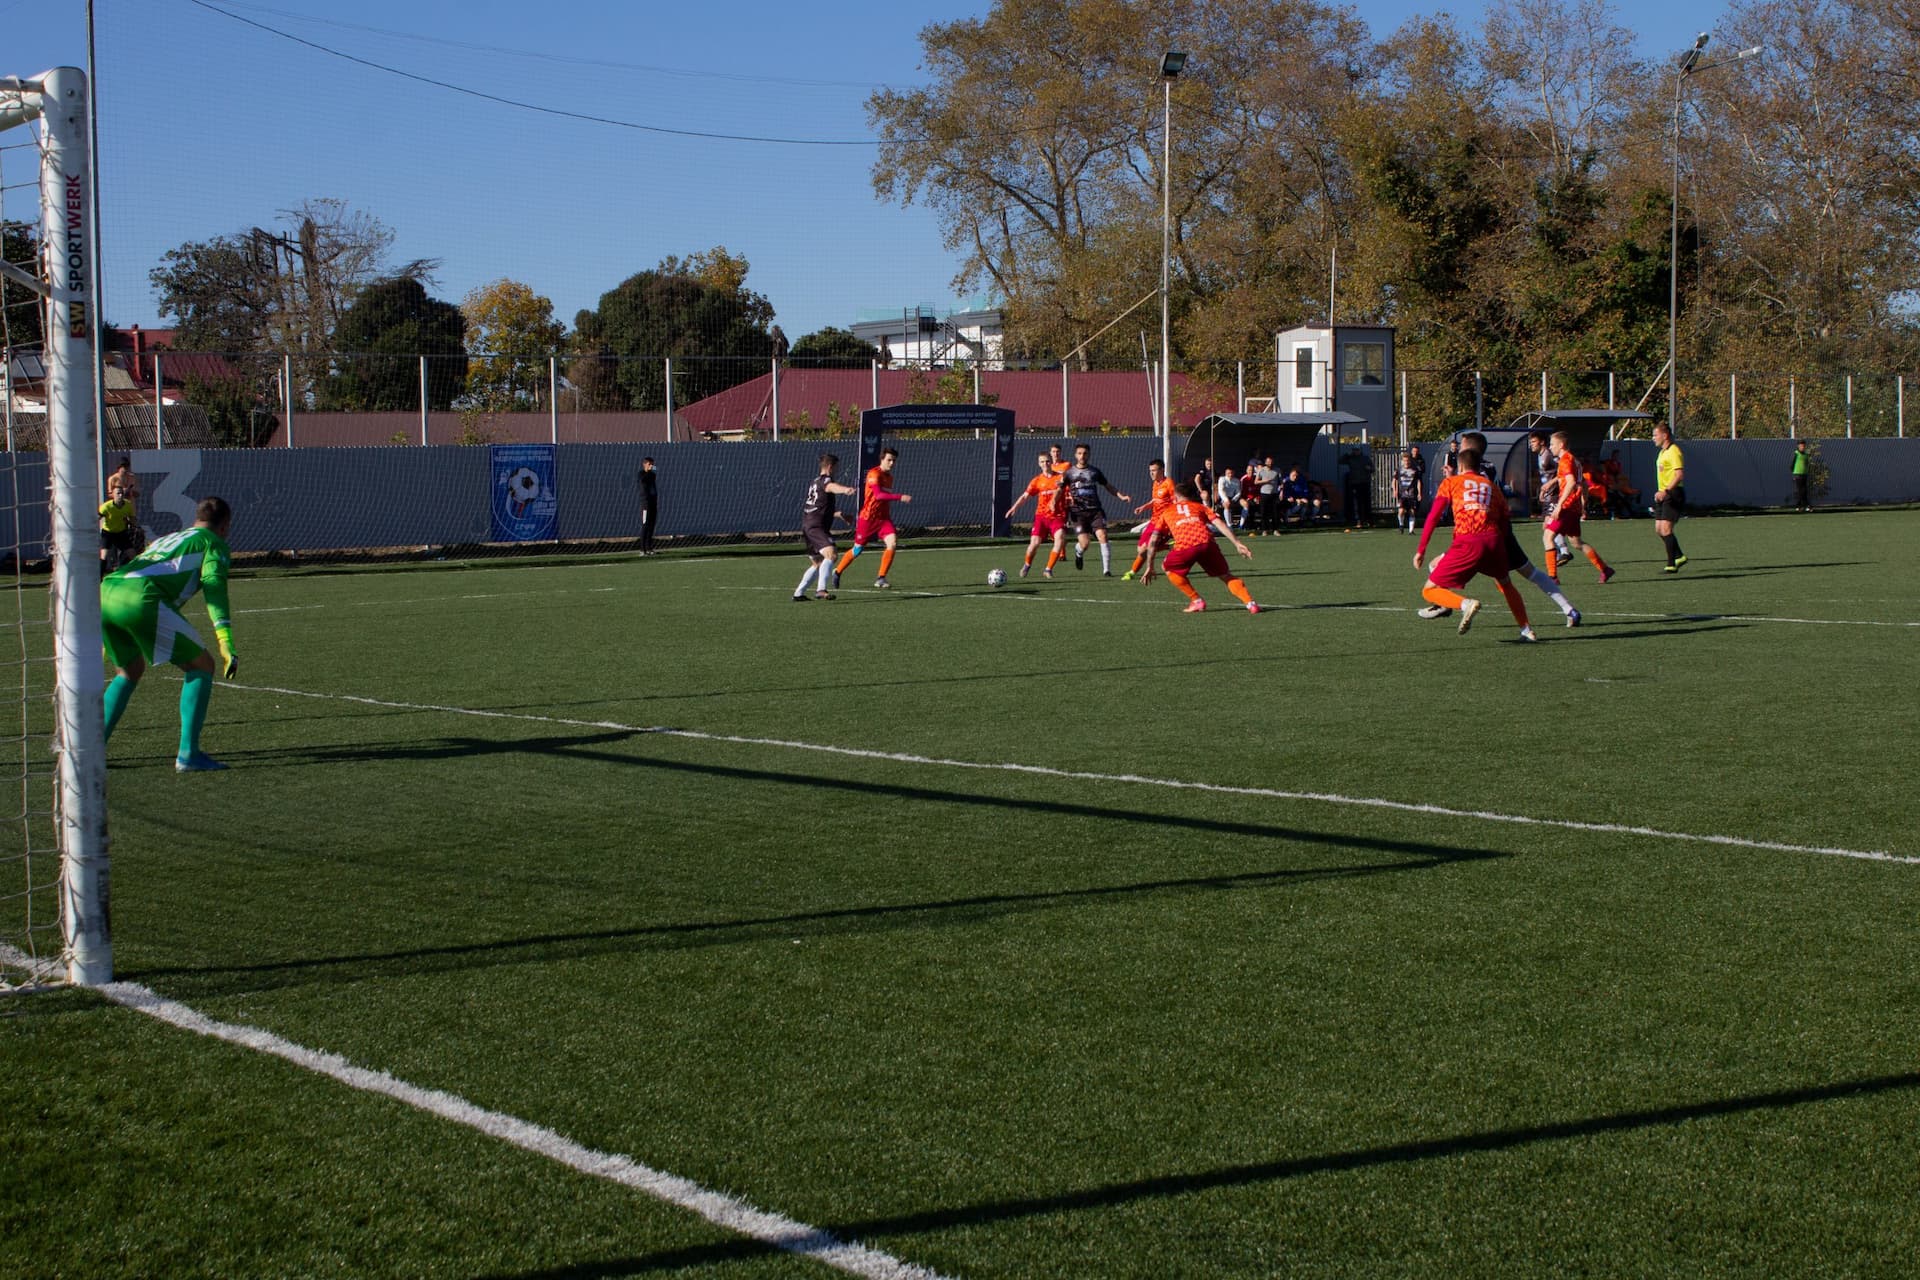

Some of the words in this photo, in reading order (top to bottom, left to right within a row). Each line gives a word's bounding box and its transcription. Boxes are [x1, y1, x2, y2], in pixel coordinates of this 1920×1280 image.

[66, 174, 84, 292] SPORTWERK
[71, 302, 85, 336] SW
[1176, 504, 1191, 517] 4
